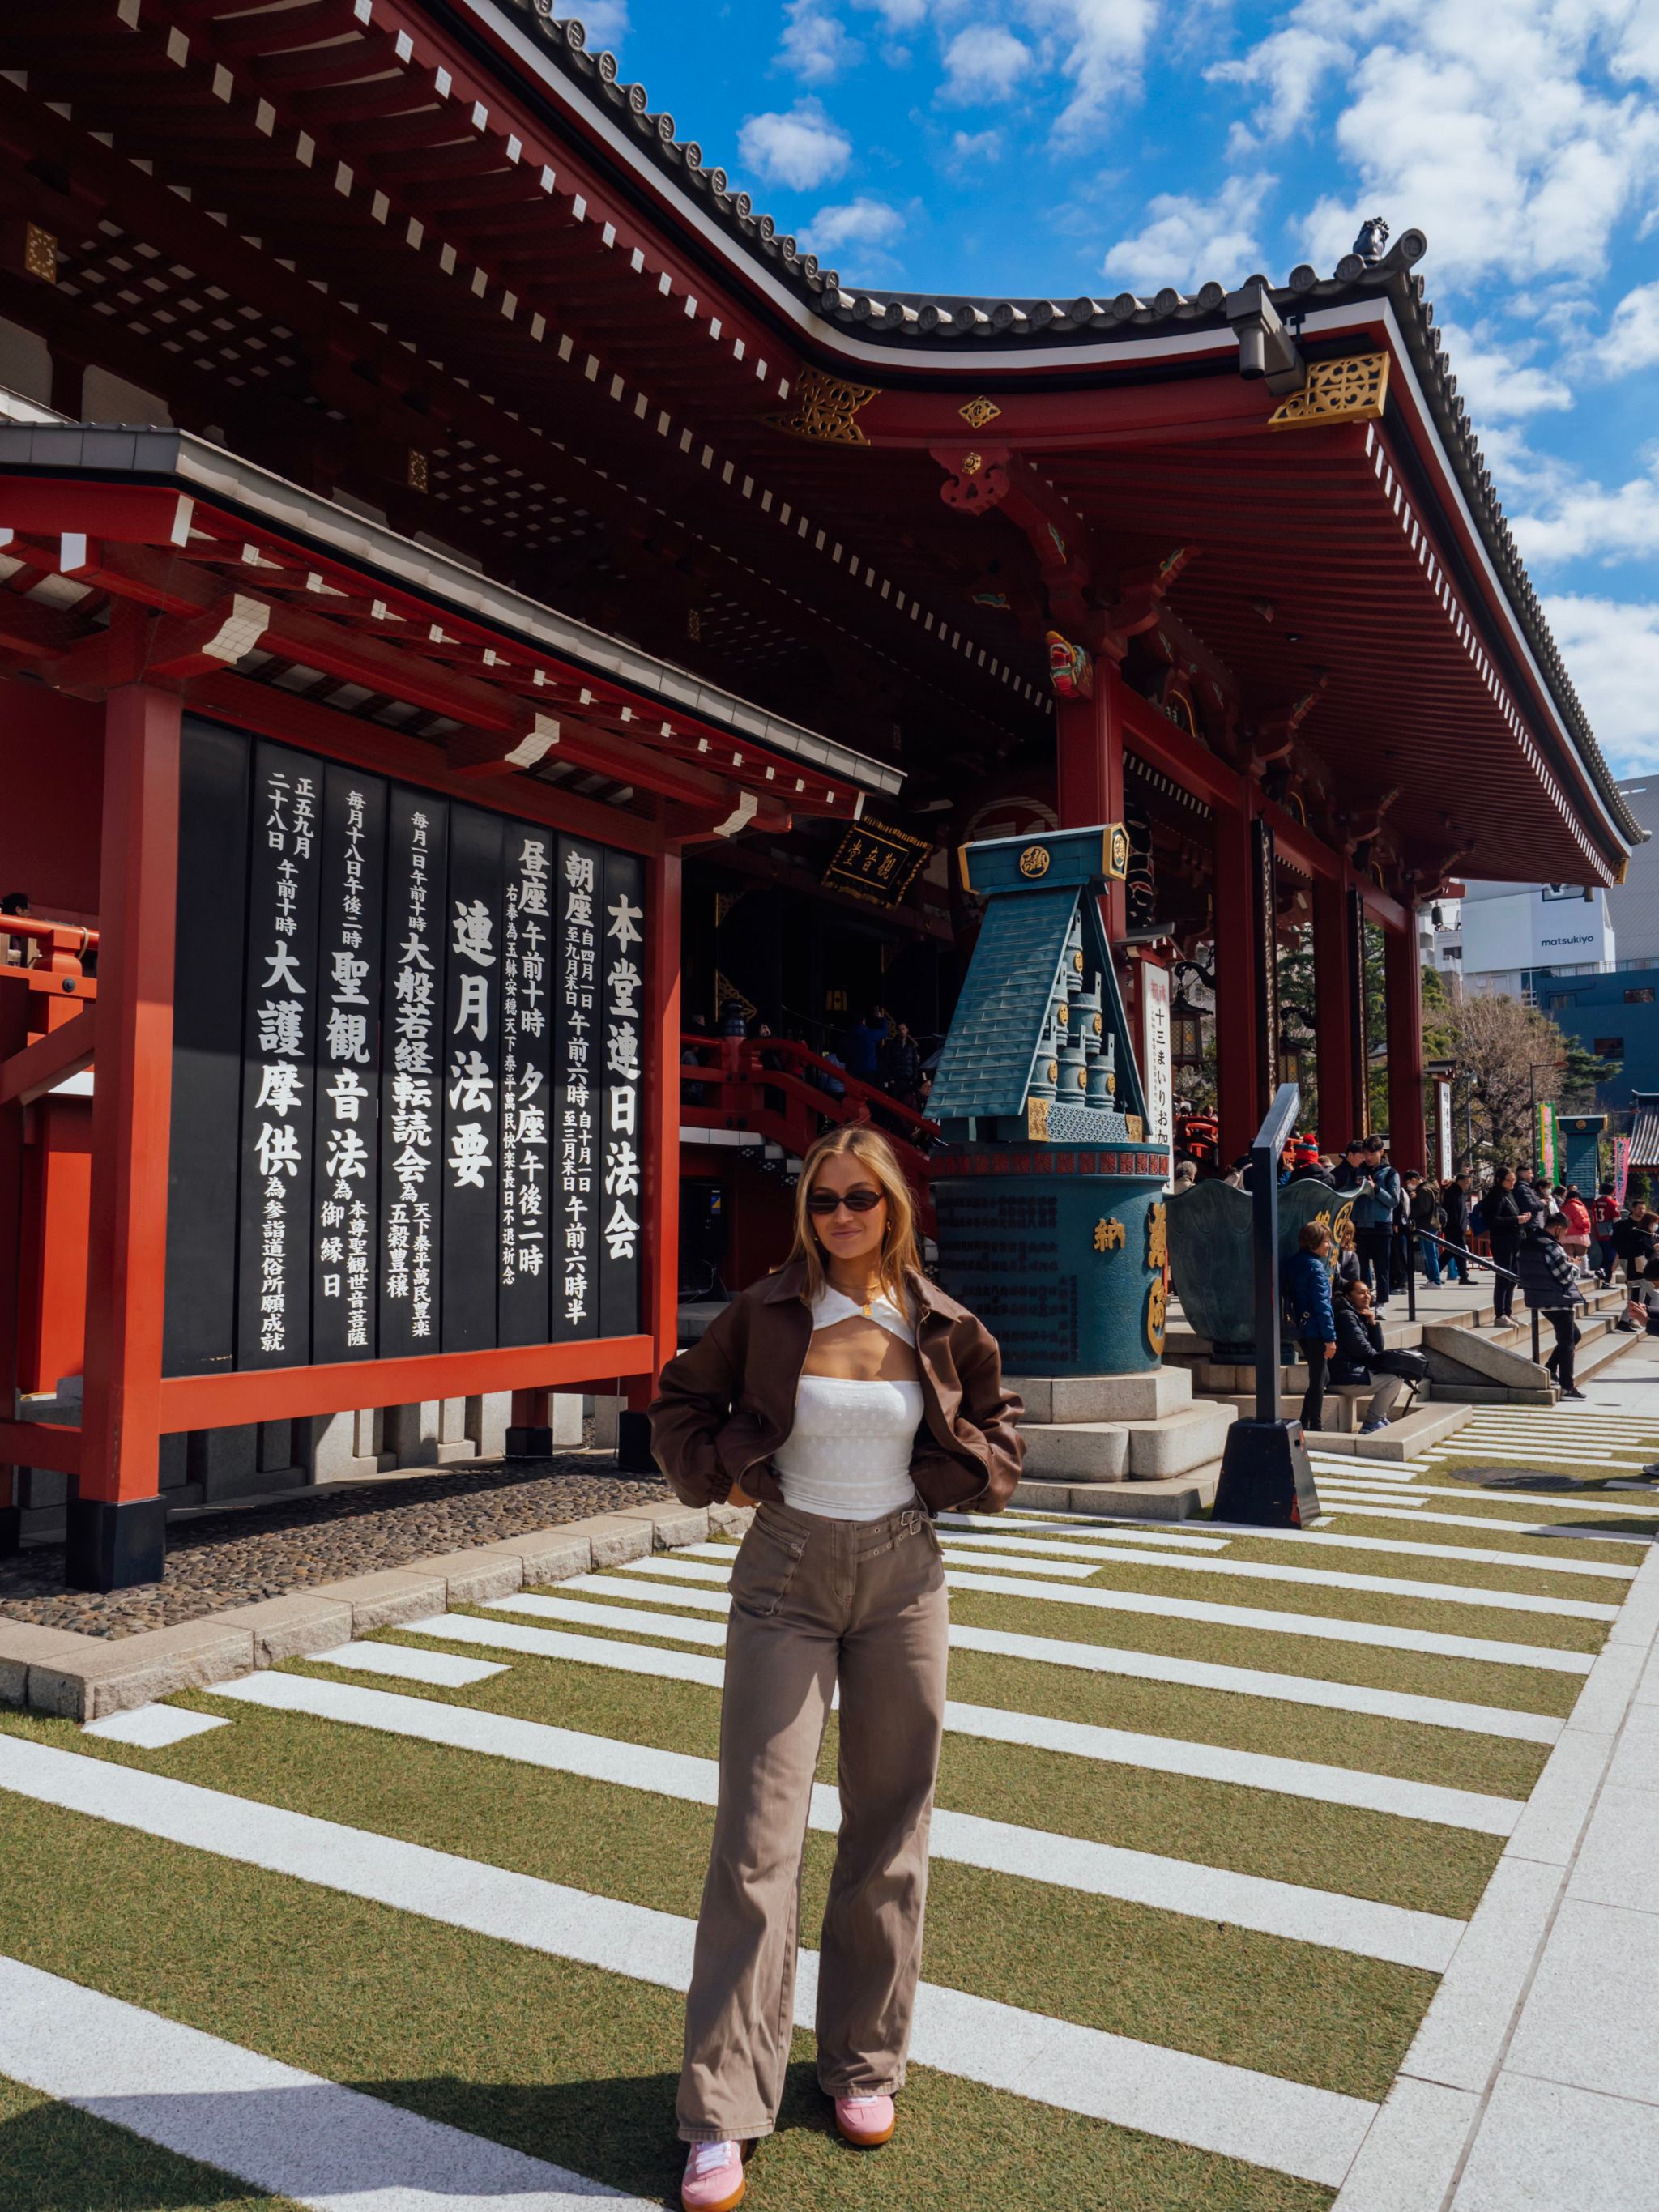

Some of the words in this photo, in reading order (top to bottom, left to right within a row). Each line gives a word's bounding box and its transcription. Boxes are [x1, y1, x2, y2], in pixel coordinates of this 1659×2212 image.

[266, 772, 291, 851] 二十八日
[292, 778, 316, 859] 正五九月
[275, 859, 299, 936] 午前十時
[342, 790, 367, 949] 毎月十八日午後二時
[408, 811, 429, 932] 毎月一日午前十時
[564, 850, 595, 931] 朝座
[517, 838, 551, 1038] 昼座午前十時
[564, 926, 581, 1007] 至九月末日
[580, 928, 595, 1010] 自四月一日
[1541, 935, 1594, 947] matsukiyo
[254, 940, 307, 1177] 大護摩供
[326, 951, 370, 1178] 聖観音法
[390, 931, 435, 1183] 大般若経転読会
[447, 899, 497, 1191] 連月法要
[566, 1010, 591, 1109] 午前六時
[603, 893, 643, 1260] 本堂連日法会
[332, 1178, 353, 1200] 為
[399, 1182, 419, 1203] 為
[516, 1062, 548, 1276] 夕座午後二時
[561, 1110, 578, 1192] 至三月末日
[578, 1110, 593, 1193] 自十月一日
[320, 1200, 345, 1298] 御縁日
[346, 1200, 370, 1347] 本尊聖観世音菩薩
[564, 1195, 588, 1325] 午前六時半
